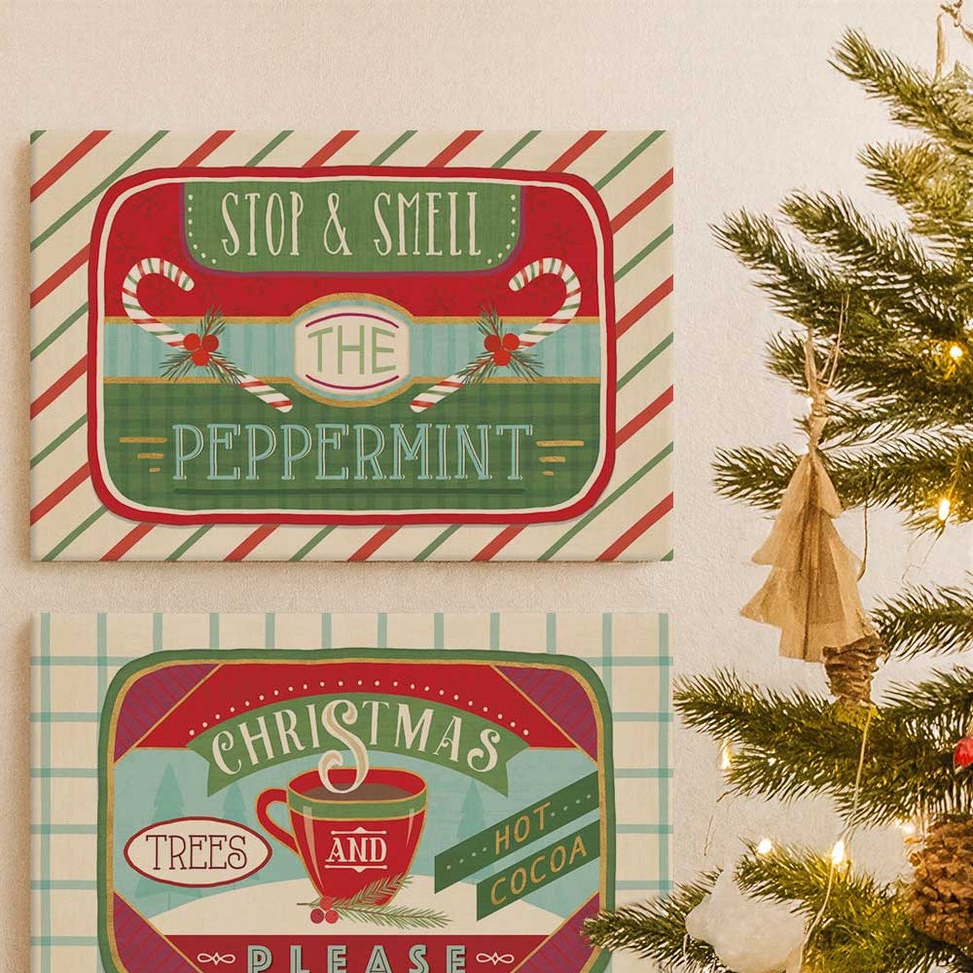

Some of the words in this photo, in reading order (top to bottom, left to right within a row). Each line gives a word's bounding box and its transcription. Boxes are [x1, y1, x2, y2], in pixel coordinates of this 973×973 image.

[221, 192, 304, 257] STOP
[325, 192, 352, 256] &
[373, 191, 481, 257] SMELL
[308, 325, 396, 375] THE
[172, 424, 532, 480] PEPPERMINT
[212, 700, 501, 794] CHRISTMAS
[146, 835, 248, 871] TREES
[326, 837, 387, 863] AND
[494, 803, 553, 856] HOT
[490, 836, 587, 907] COCOA
